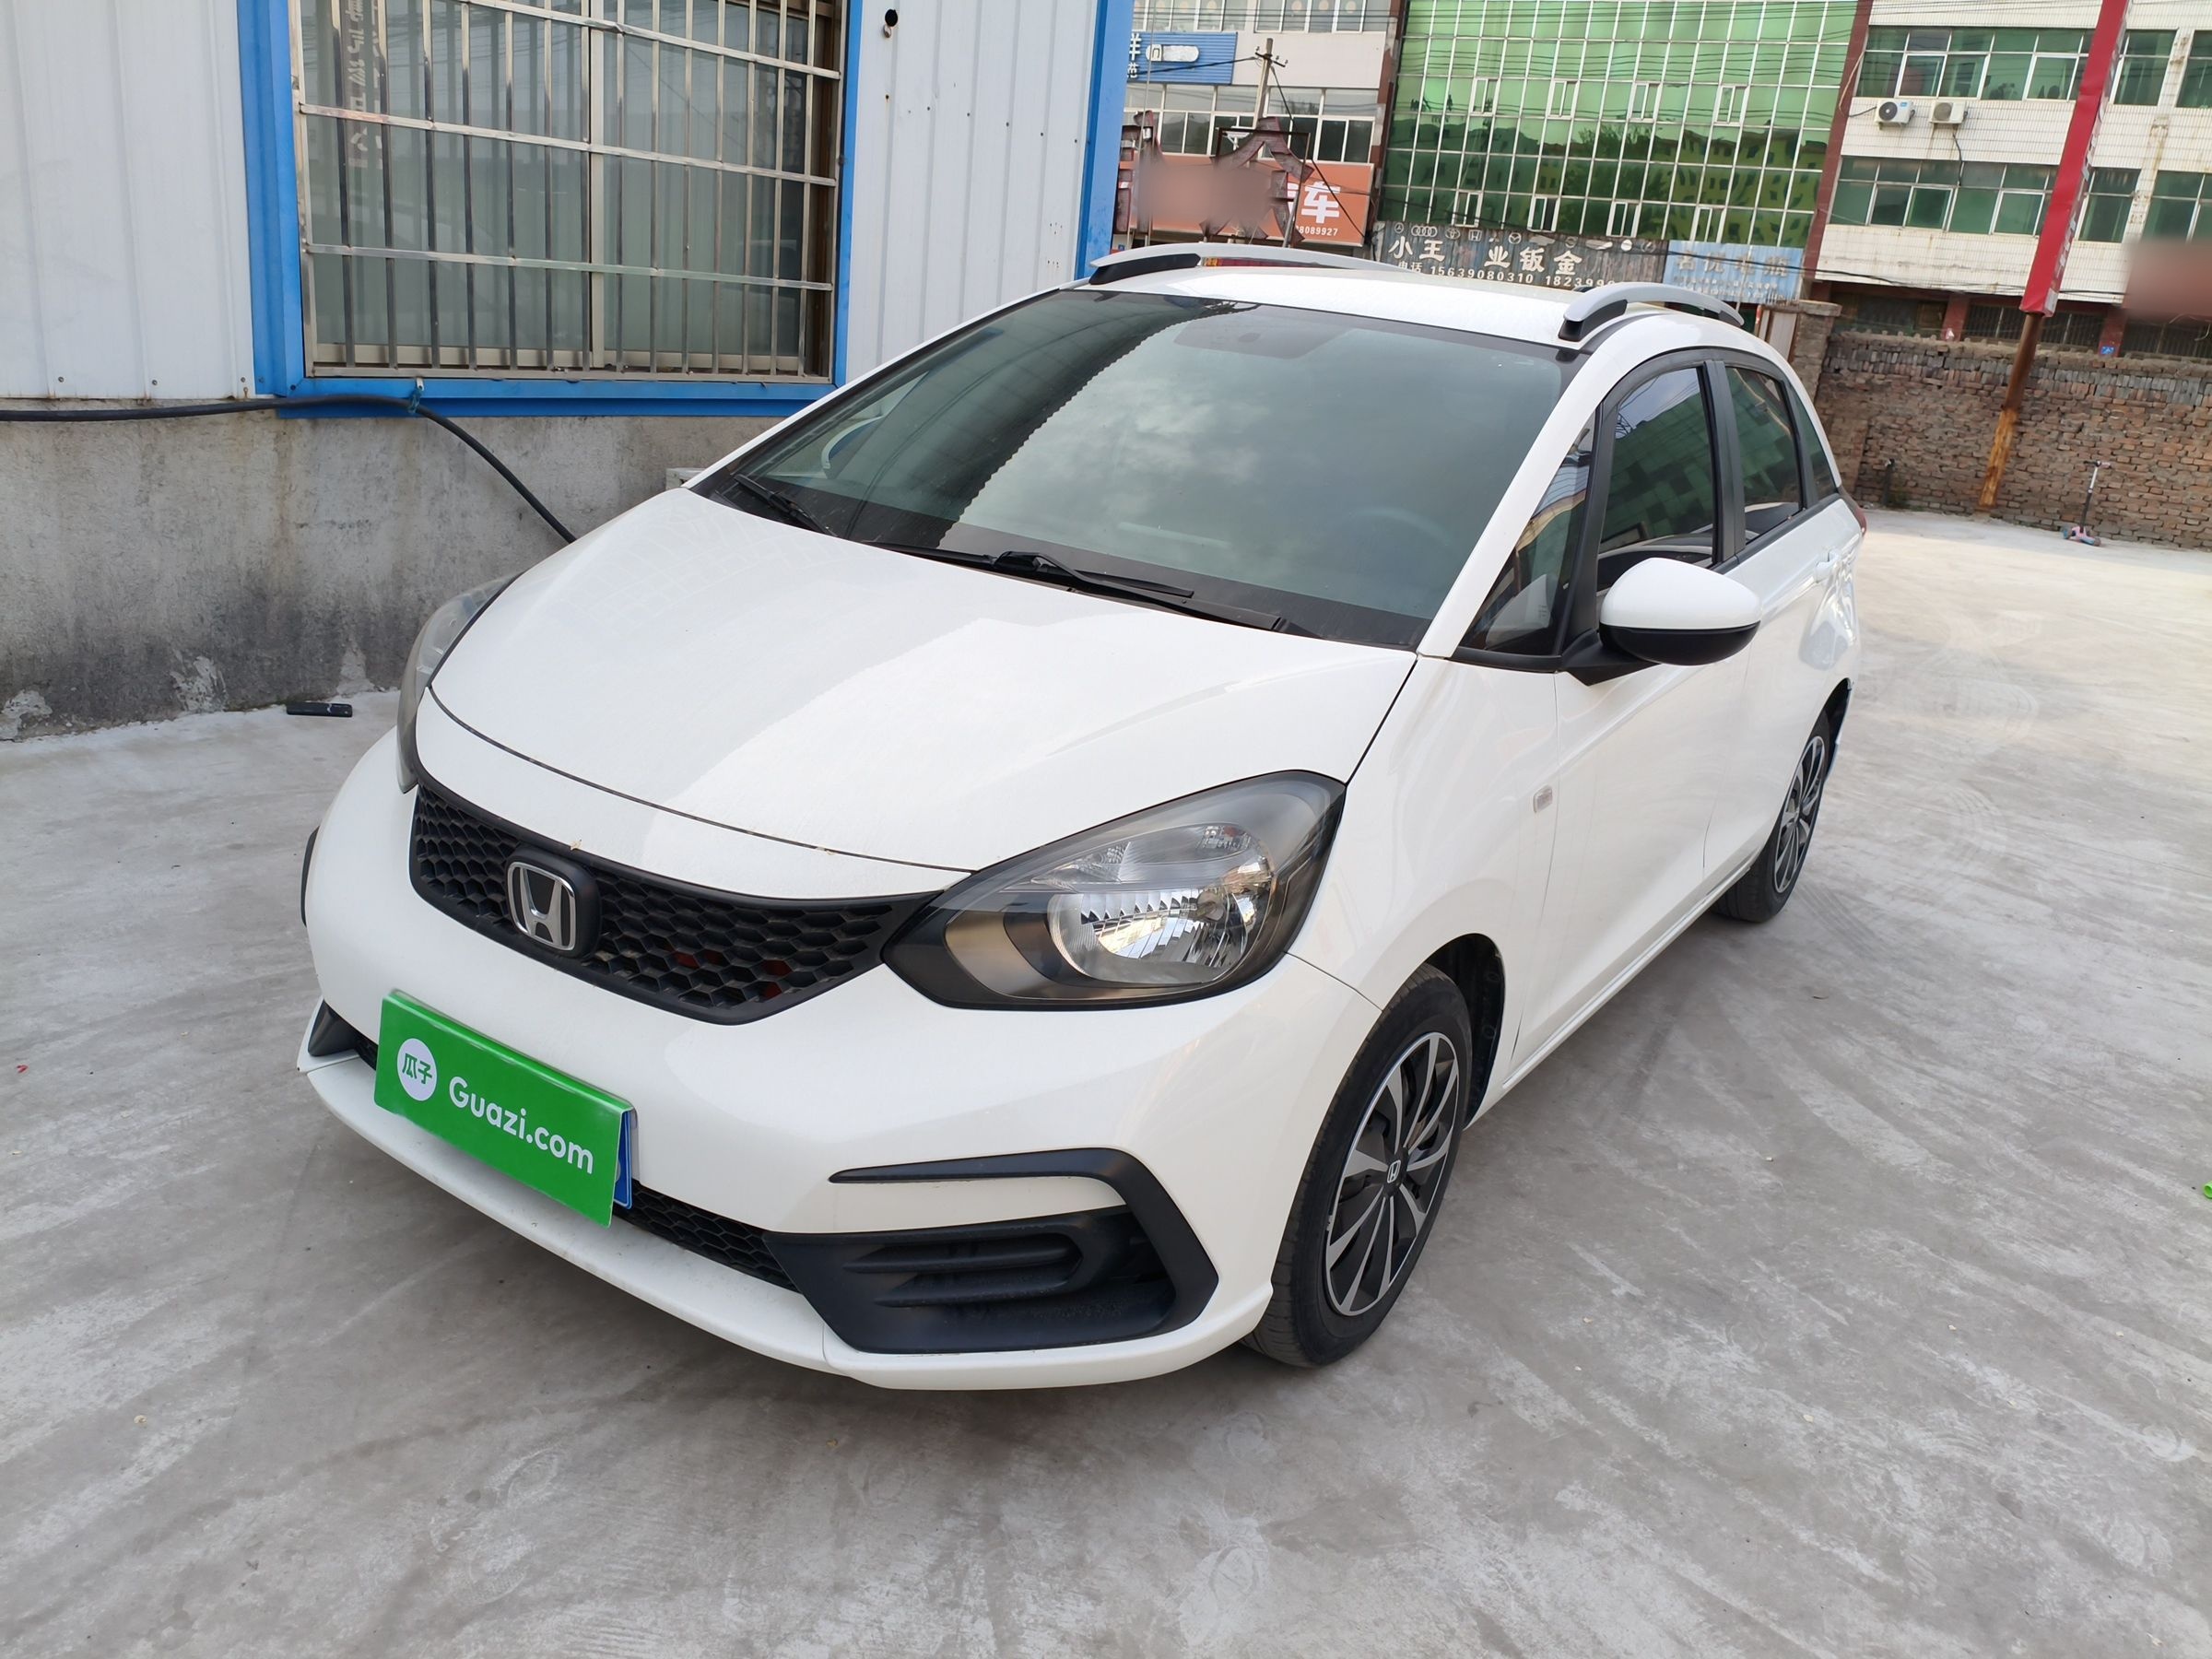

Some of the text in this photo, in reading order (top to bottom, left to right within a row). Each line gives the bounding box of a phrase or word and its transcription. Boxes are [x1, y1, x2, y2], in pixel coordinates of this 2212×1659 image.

[1287, 181, 1341, 224] 车
[1430, 265, 1534, 284] 15639080310
[401, 1052, 433, 1085] 瓜子
[449, 1076, 594, 1175] Guazi.com
